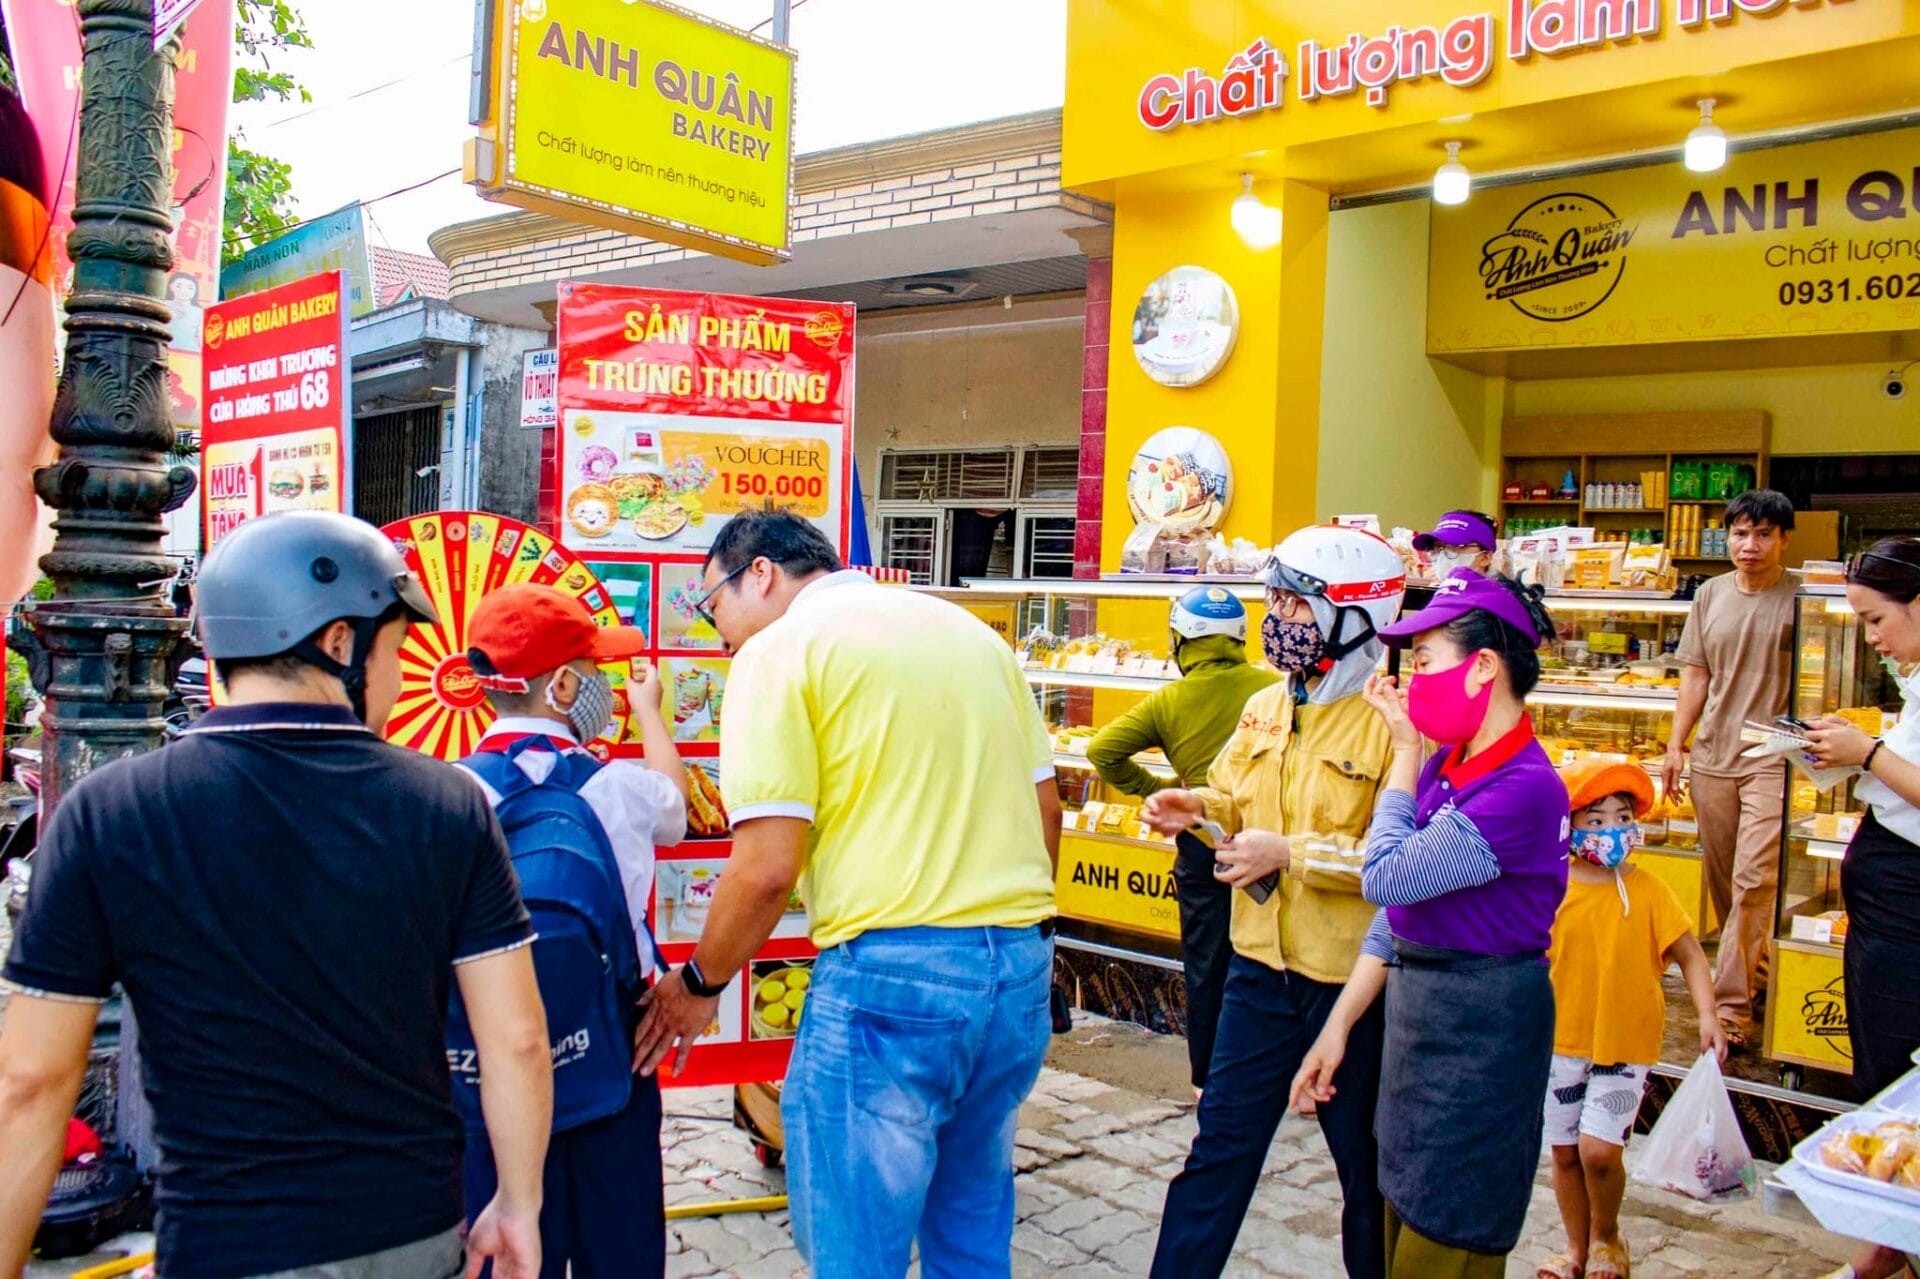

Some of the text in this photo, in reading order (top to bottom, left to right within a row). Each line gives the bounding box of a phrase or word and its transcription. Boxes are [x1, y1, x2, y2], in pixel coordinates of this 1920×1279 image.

[537, 21, 774, 132] ANH QUÂN
[1138, 37, 1285, 132] Chất
[1299, 13, 1493, 108] lượng
[672, 112, 772, 163] BAKERY
[537, 130, 766, 208] Chất lượng làm nên thương hiệu
[1671, 178, 1819, 239] ANH
[1765, 238, 1838, 268] Chất
[225, 315, 251, 341] ANH
[252, 303, 289, 334] QUÂN
[290, 291, 338, 324] BAKERY
[624, 304, 690, 345] SẢN
[699, 309, 791, 353] PHẨM
[248, 357, 278, 383] KHAI
[300, 370, 330, 411] 68
[583, 356, 827, 404] TRÚNG THƯỞNG
[210, 464, 248, 500] MUA
[715, 446, 826, 472] VOUCHER
[721, 472, 823, 498] 150.000
[1072, 860, 1119, 891] ANH
